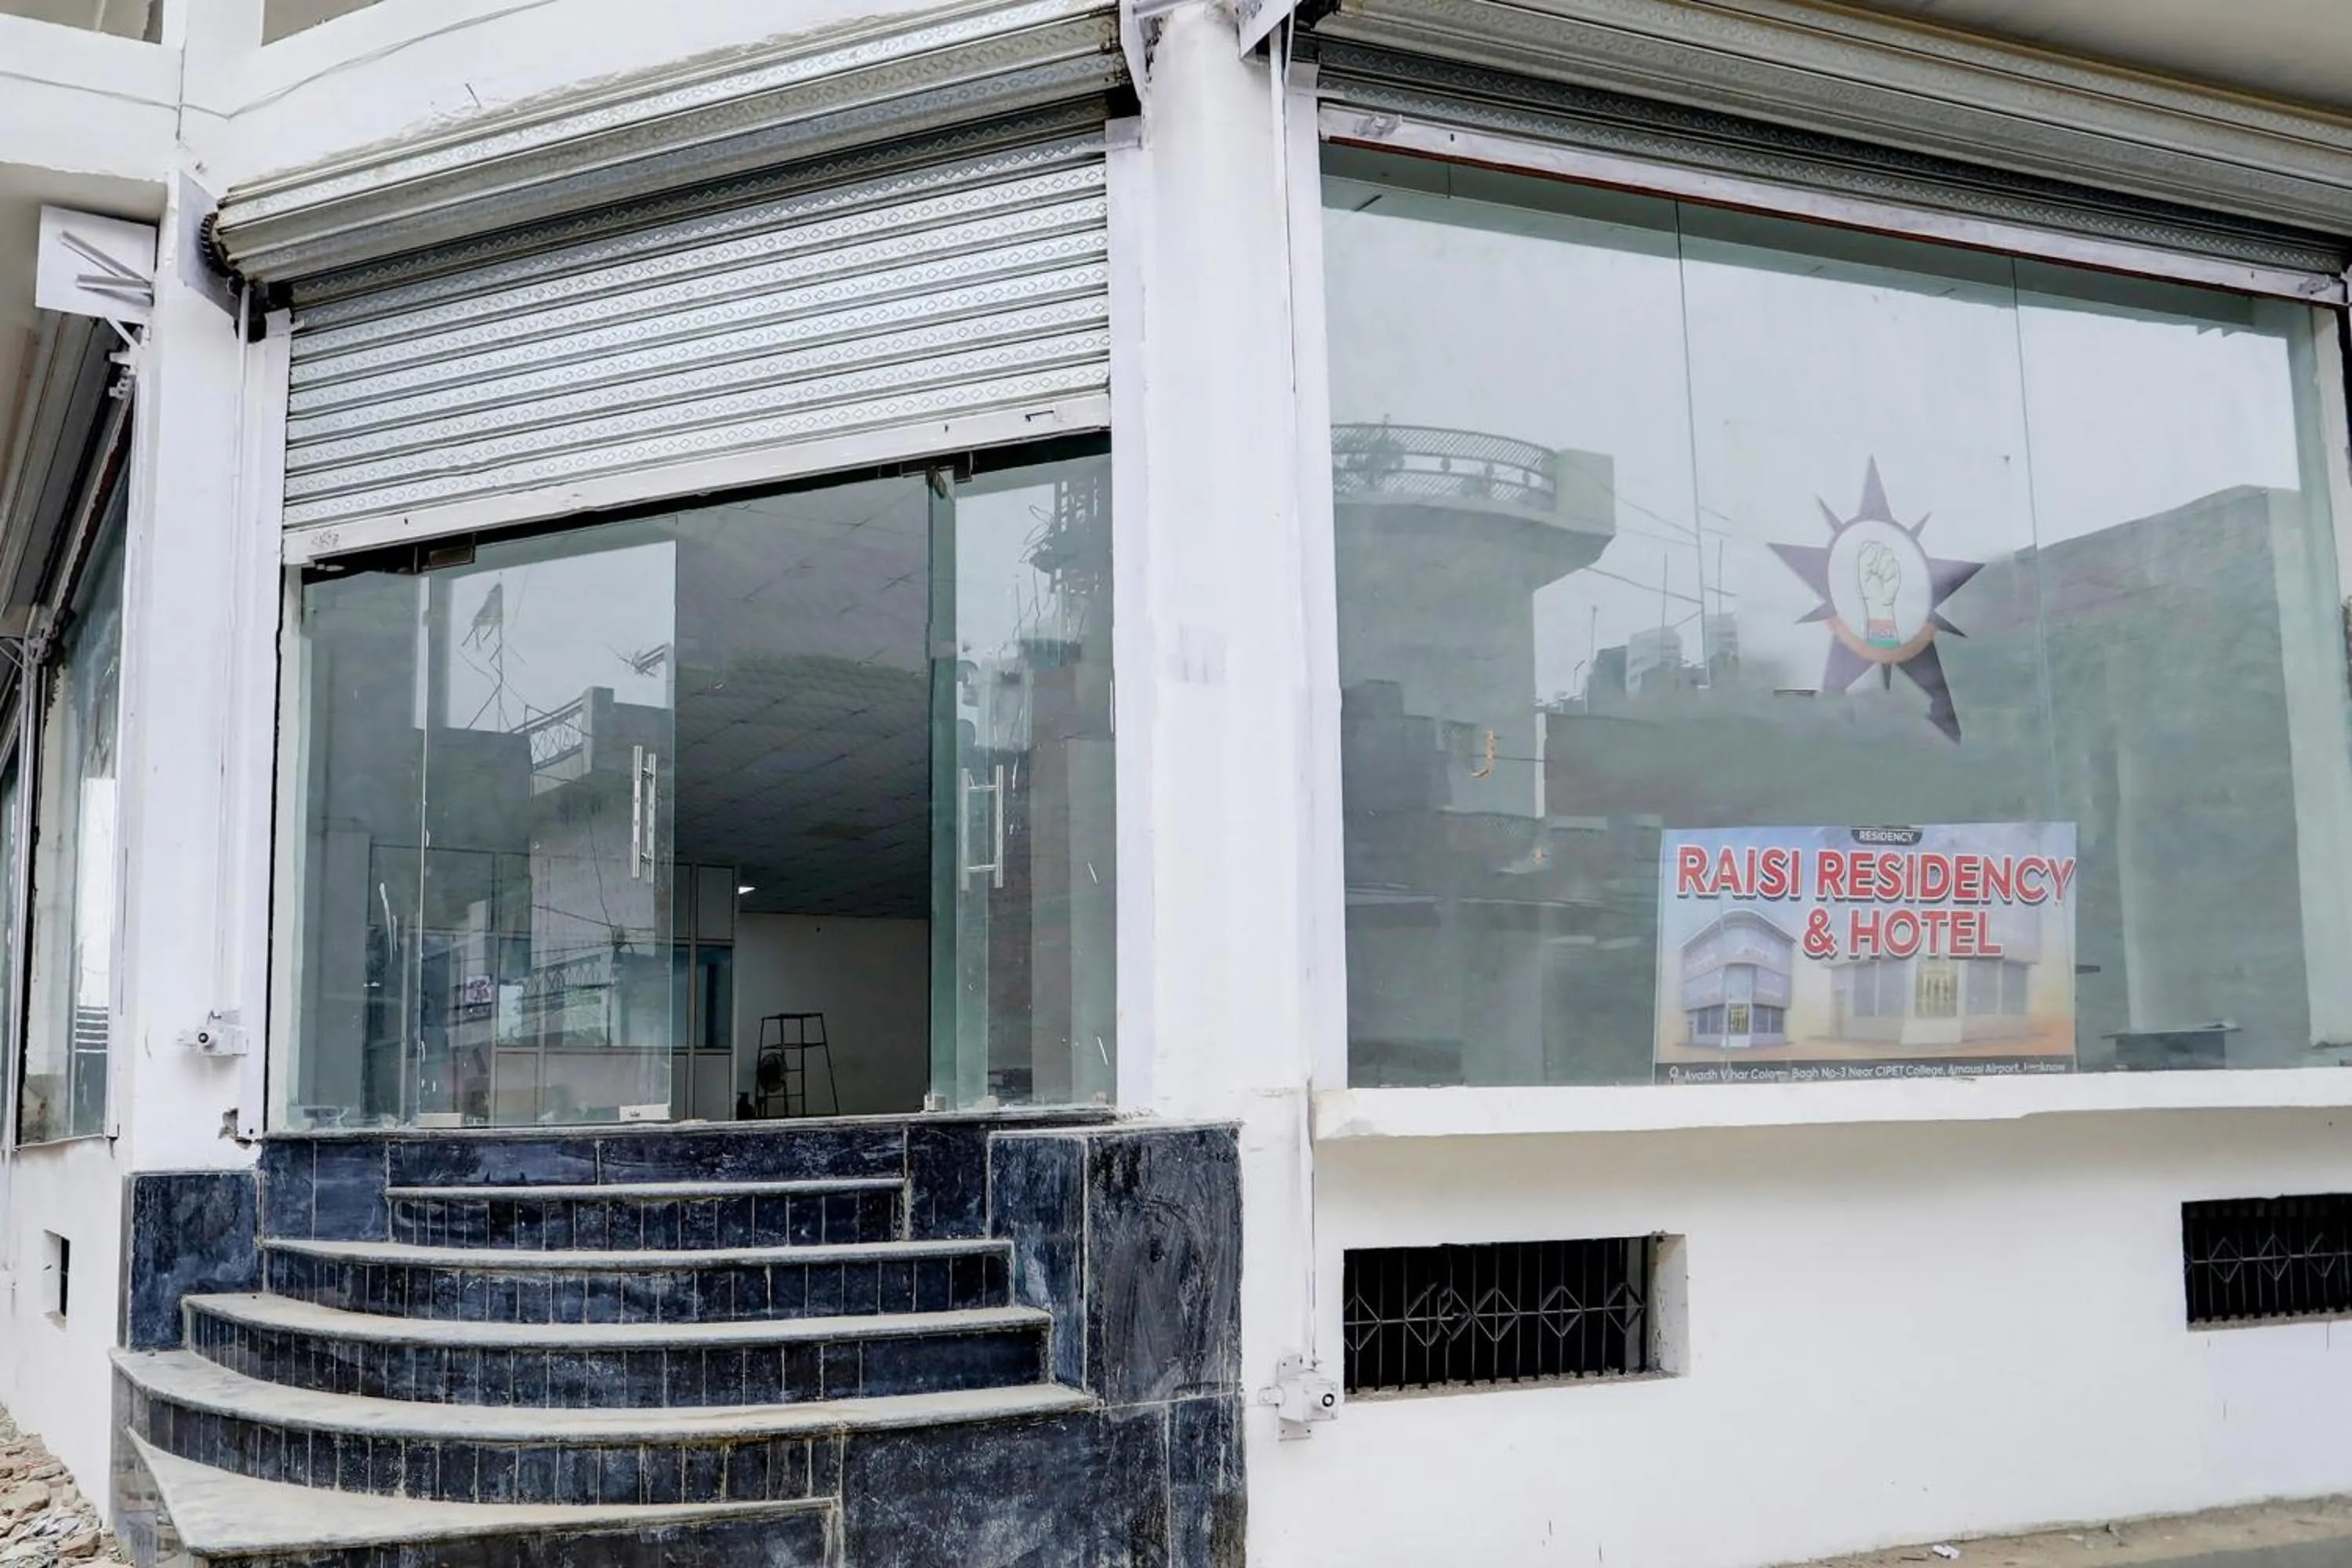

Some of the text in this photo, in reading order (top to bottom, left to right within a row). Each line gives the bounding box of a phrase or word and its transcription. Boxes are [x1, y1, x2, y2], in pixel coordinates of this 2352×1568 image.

[1859, 830, 1914, 842] RESIDENCY
[1676, 844, 2075, 906] RAISI RESIDENCY
[1802, 907, 2003, 957] & HOTEL
[1685, 1069, 1718, 1081] Avadh
[1720, 1069, 1749, 1080] Vhar
[1751, 1067, 1788, 1080] Colo
[1791, 1067, 1819, 1080] Bagh
[1821, 1066, 1846, 1078] No-3
[1848, 1065, 1874, 1077] Near
[1875, 1065, 1904, 1076] CIPET
[2024, 1062, 2065, 1073] know
